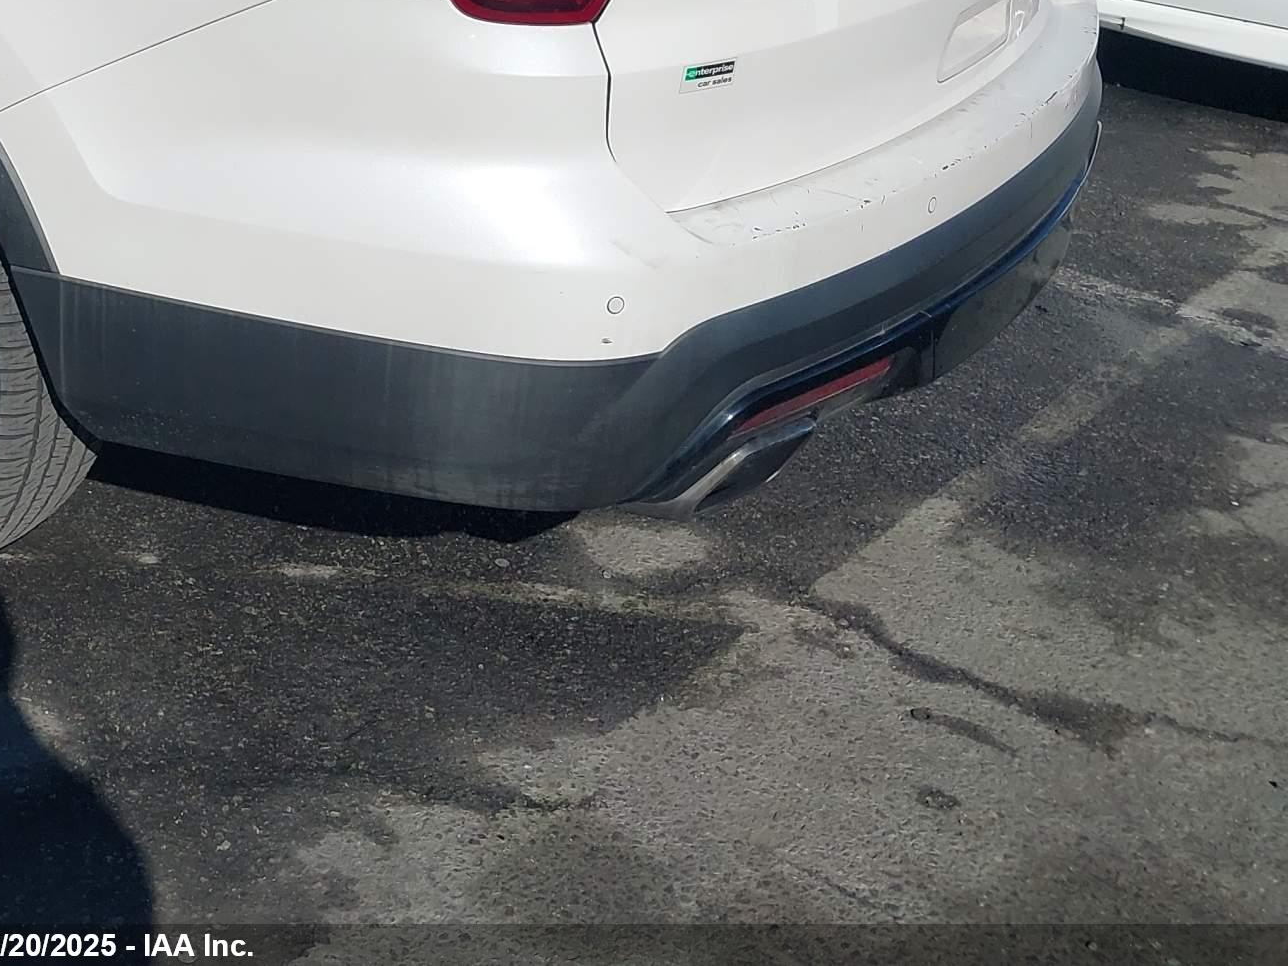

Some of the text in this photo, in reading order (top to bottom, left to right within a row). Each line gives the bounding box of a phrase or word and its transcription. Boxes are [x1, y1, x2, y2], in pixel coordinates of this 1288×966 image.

[686, 61, 735, 78] enterprise
[697, 76, 732, 88] car sales
